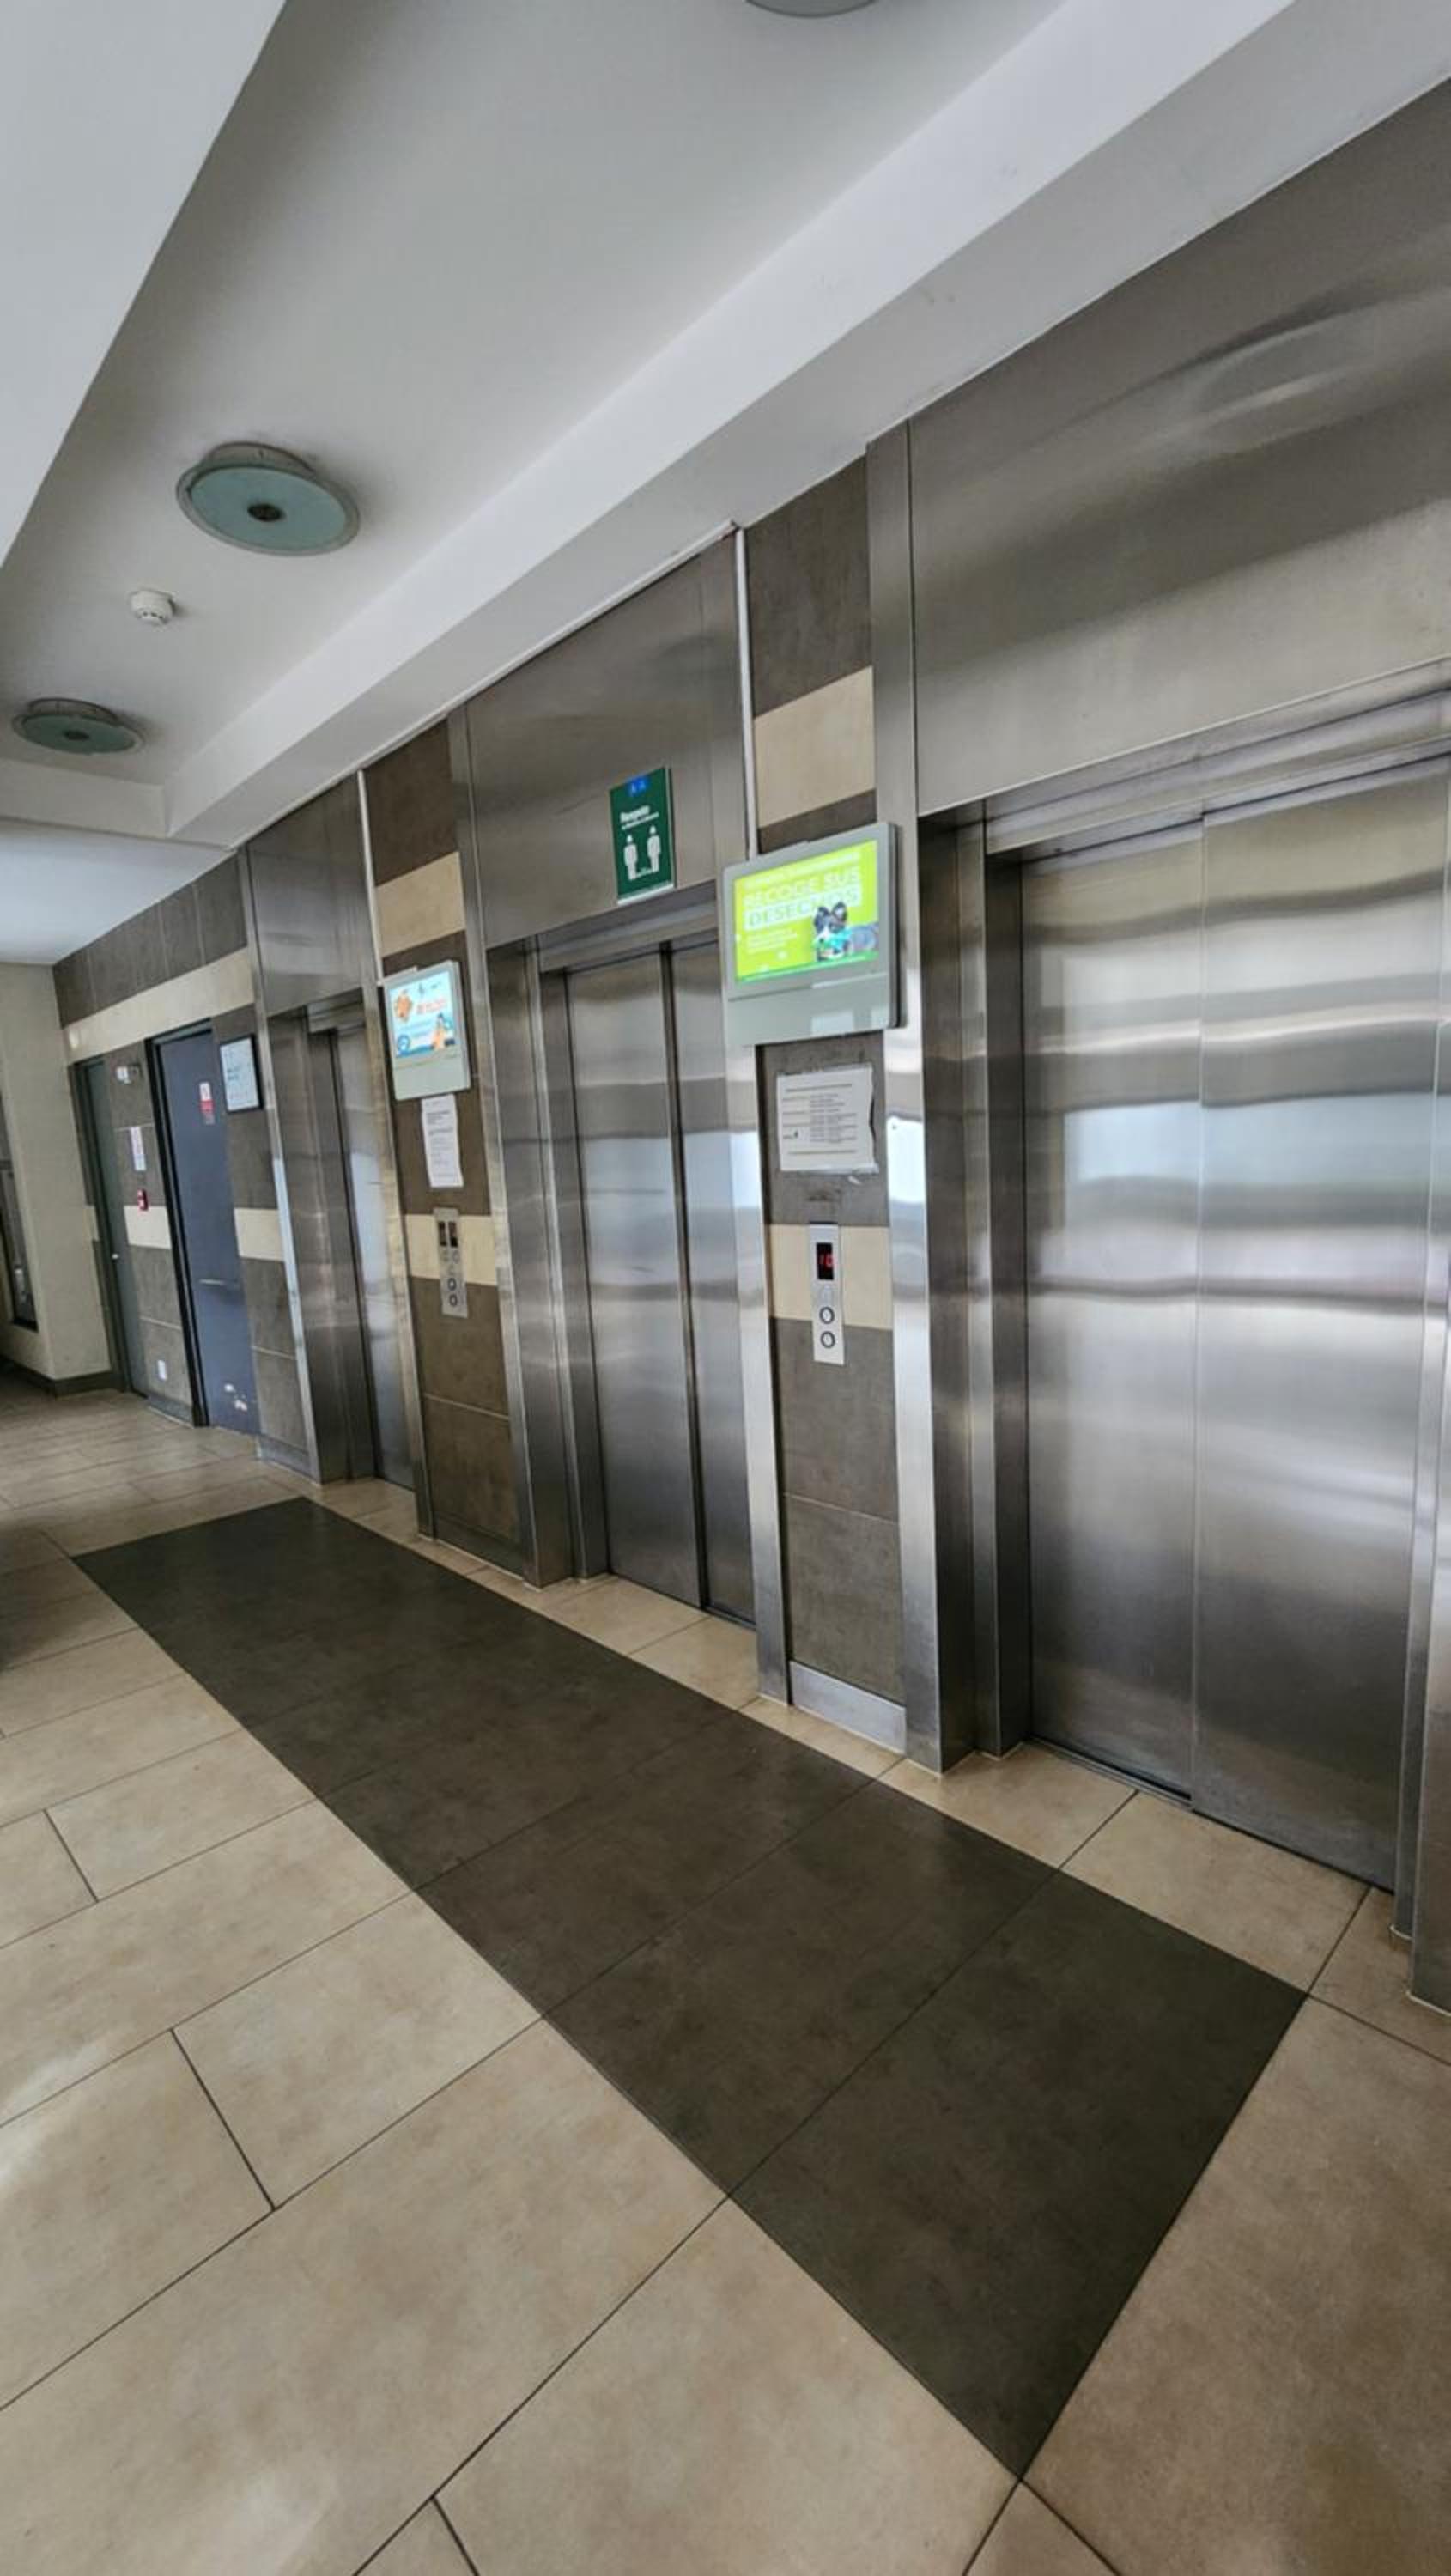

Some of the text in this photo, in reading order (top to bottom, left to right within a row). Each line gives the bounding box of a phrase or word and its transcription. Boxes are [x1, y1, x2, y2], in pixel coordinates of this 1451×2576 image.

[744, 877, 819, 907] RECOGE
[824, 866, 860, 890] SUS
[749, 890, 859, 927] DESECHOS
